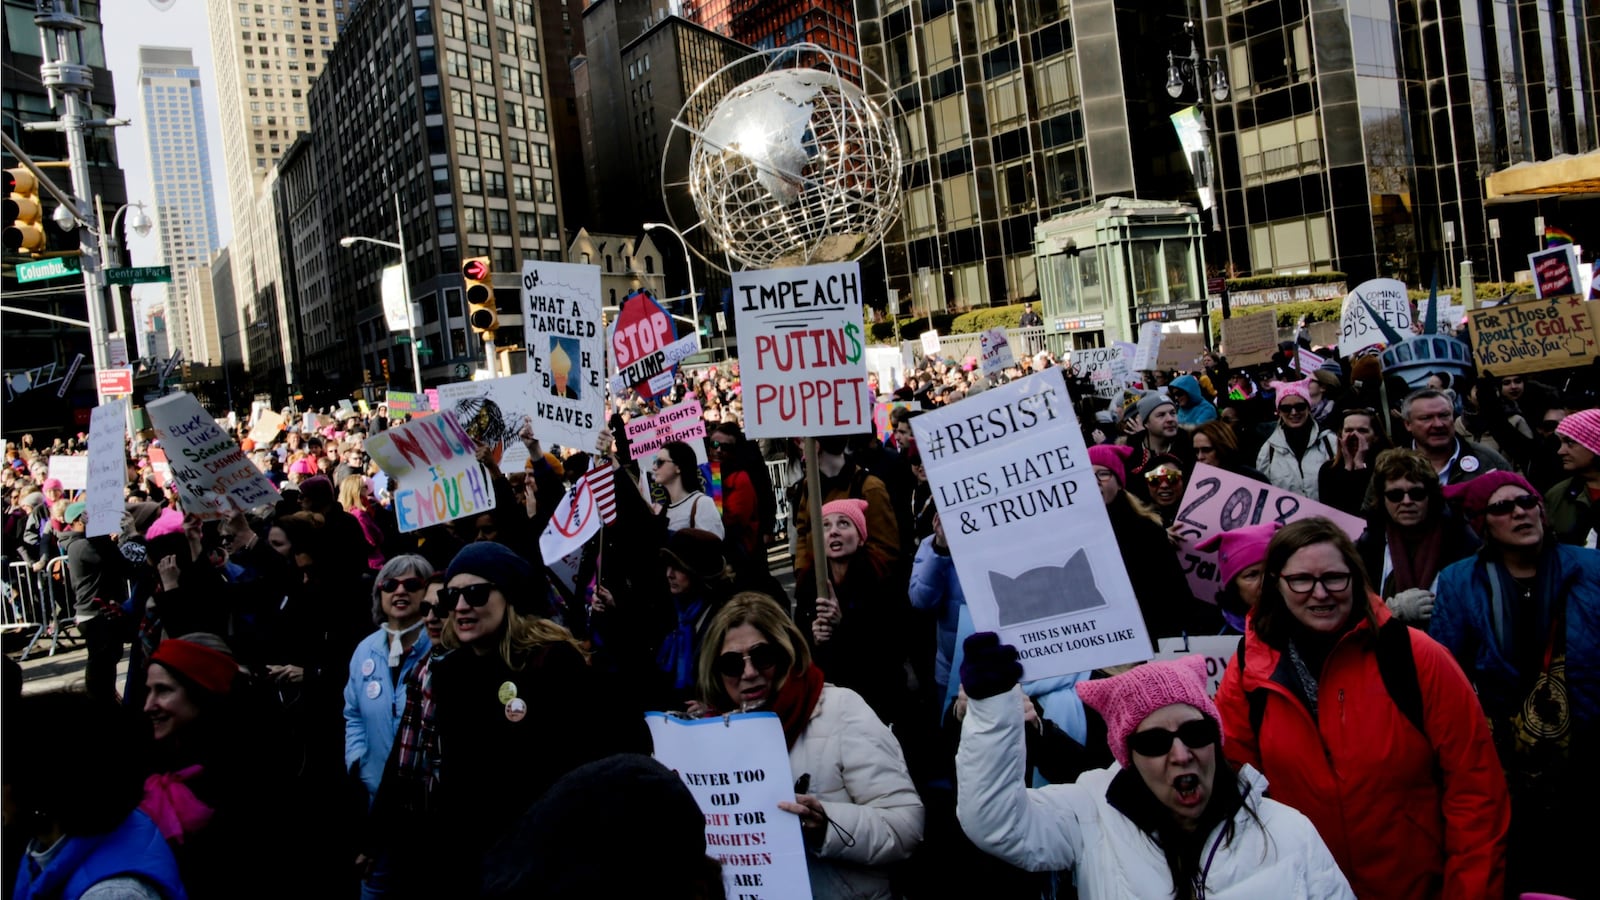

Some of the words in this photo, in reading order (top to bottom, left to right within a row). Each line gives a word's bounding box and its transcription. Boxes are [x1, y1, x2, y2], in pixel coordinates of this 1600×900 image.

[20, 262, 67, 280] Columbus
[109, 268, 142, 278] Central
[146, 267, 166, 277] Park
[739, 272, 859, 312] IMPEACH
[1267, 291, 1291, 302] HOTEL
[1295, 289, 1310, 300] AND
[1366, 290, 1402, 300] COMING
[530, 295, 565, 315] WHAT
[571, 301, 581, 317] A
[1396, 301, 1406, 312] IS
[1499, 305, 1560, 325] Those
[530, 313, 596, 338] TANGLED
[614, 312, 668, 364] STOP
[1077, 352, 1089, 362] IF
[1476, 346, 1499, 366] We
[1498, 338, 1540, 363] Salute
[619, 350, 666, 389] TRUMP
[665, 341, 697, 364] AGENDA
[1087, 363, 1104, 371] NOT
[755, 378, 864, 426] PUPPET
[536, 402, 594, 429] WEAVES
[628, 418, 658, 435] EQUAL
[659, 406, 697, 425] RIGHTS
[927, 388, 1057, 461] #RESIST
[187, 427, 220, 446] LIVES
[631, 439, 663, 456] HUMAN
[665, 426, 703, 447] RIGHTS
[655, 424, 671, 437] are
[368, 411, 477, 477] ENOUGH
[938, 472, 1000, 508] LIES,
[1000, 446, 1075, 488] HATE
[960, 511, 981, 534] &
[982, 480, 1079, 528] TRUMP
[1177, 477, 1300, 533] 2018
[1020, 630, 1047, 644] THIS
[1048, 627, 1060, 639] IS
[1061, 620, 1097, 636] WHAT
[1016, 642, 1064, 660] OCRACY
[1067, 634, 1105, 651] LOOKS
[1106, 628, 1135, 644] LIKE
[686, 772, 730, 787] NEVER
[733, 769, 765, 784] TOO
[711, 793, 740, 806] OLD
[705, 814, 730, 826] GHT
[735, 811, 766, 825] FOR
[707, 832, 766, 846] RIGHTS!
[719, 853, 772, 866] WOMEN
[734, 873, 763, 887] ARE
